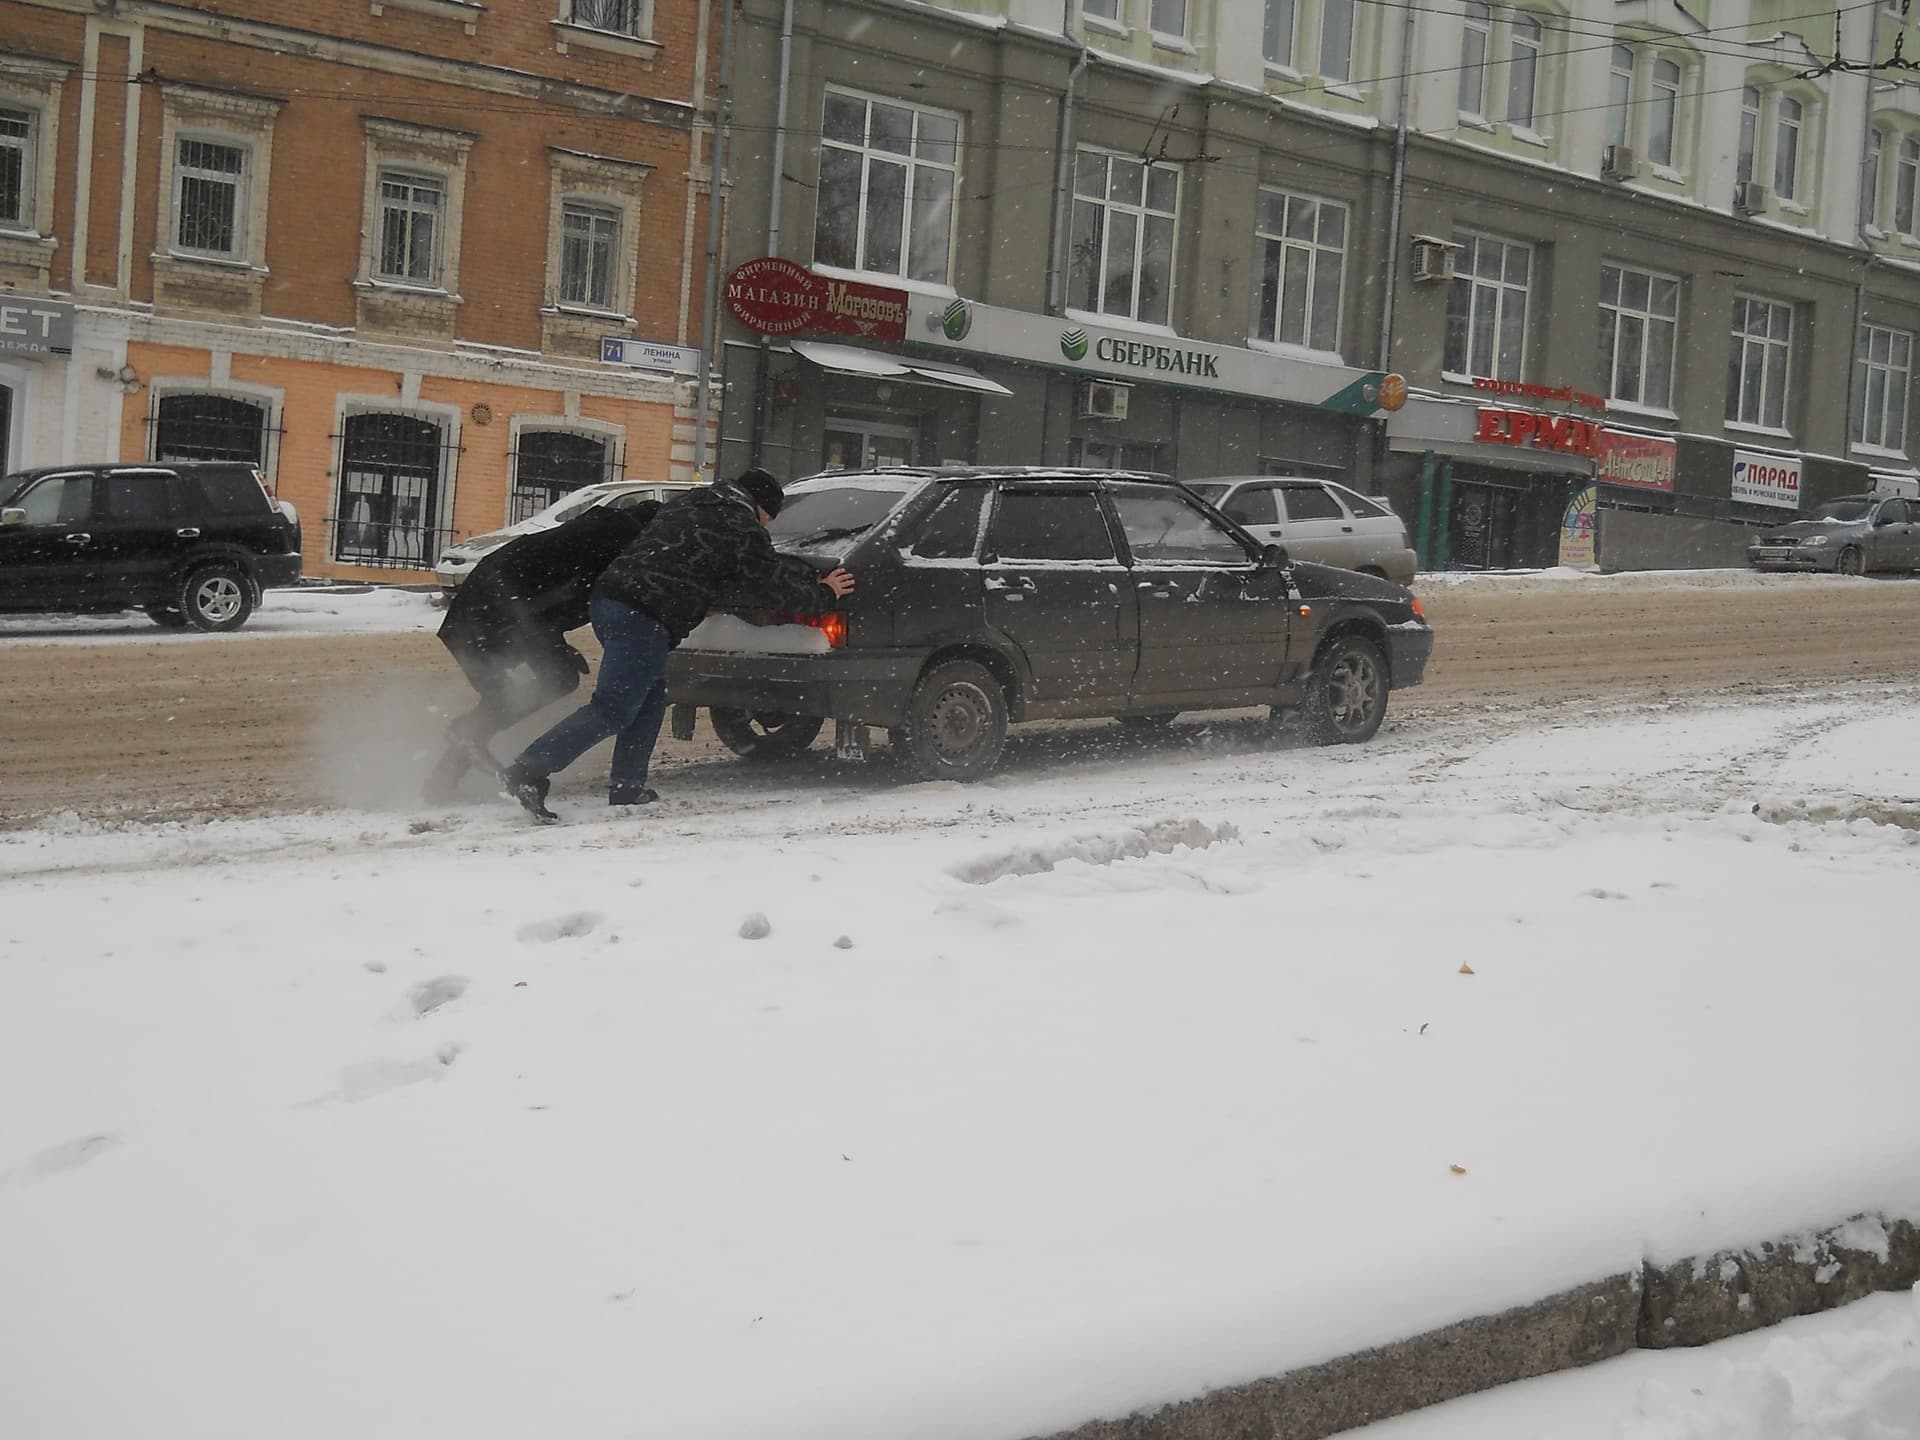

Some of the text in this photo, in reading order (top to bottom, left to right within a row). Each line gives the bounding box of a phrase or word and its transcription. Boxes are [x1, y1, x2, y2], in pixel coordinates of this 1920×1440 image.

[737, 261, 813, 290] ФИРМЕННЫЙ
[728, 283, 819, 310] МАГАЗИН
[733, 303, 811, 332] ФИРМЕННЫЙ
[605, 344, 620, 358] 71
[643, 347, 680, 360] ЛЕНИНА
[1096, 336, 1219, 378] СБЕРБАНК
[1747, 463, 1798, 490] ПАРАД
